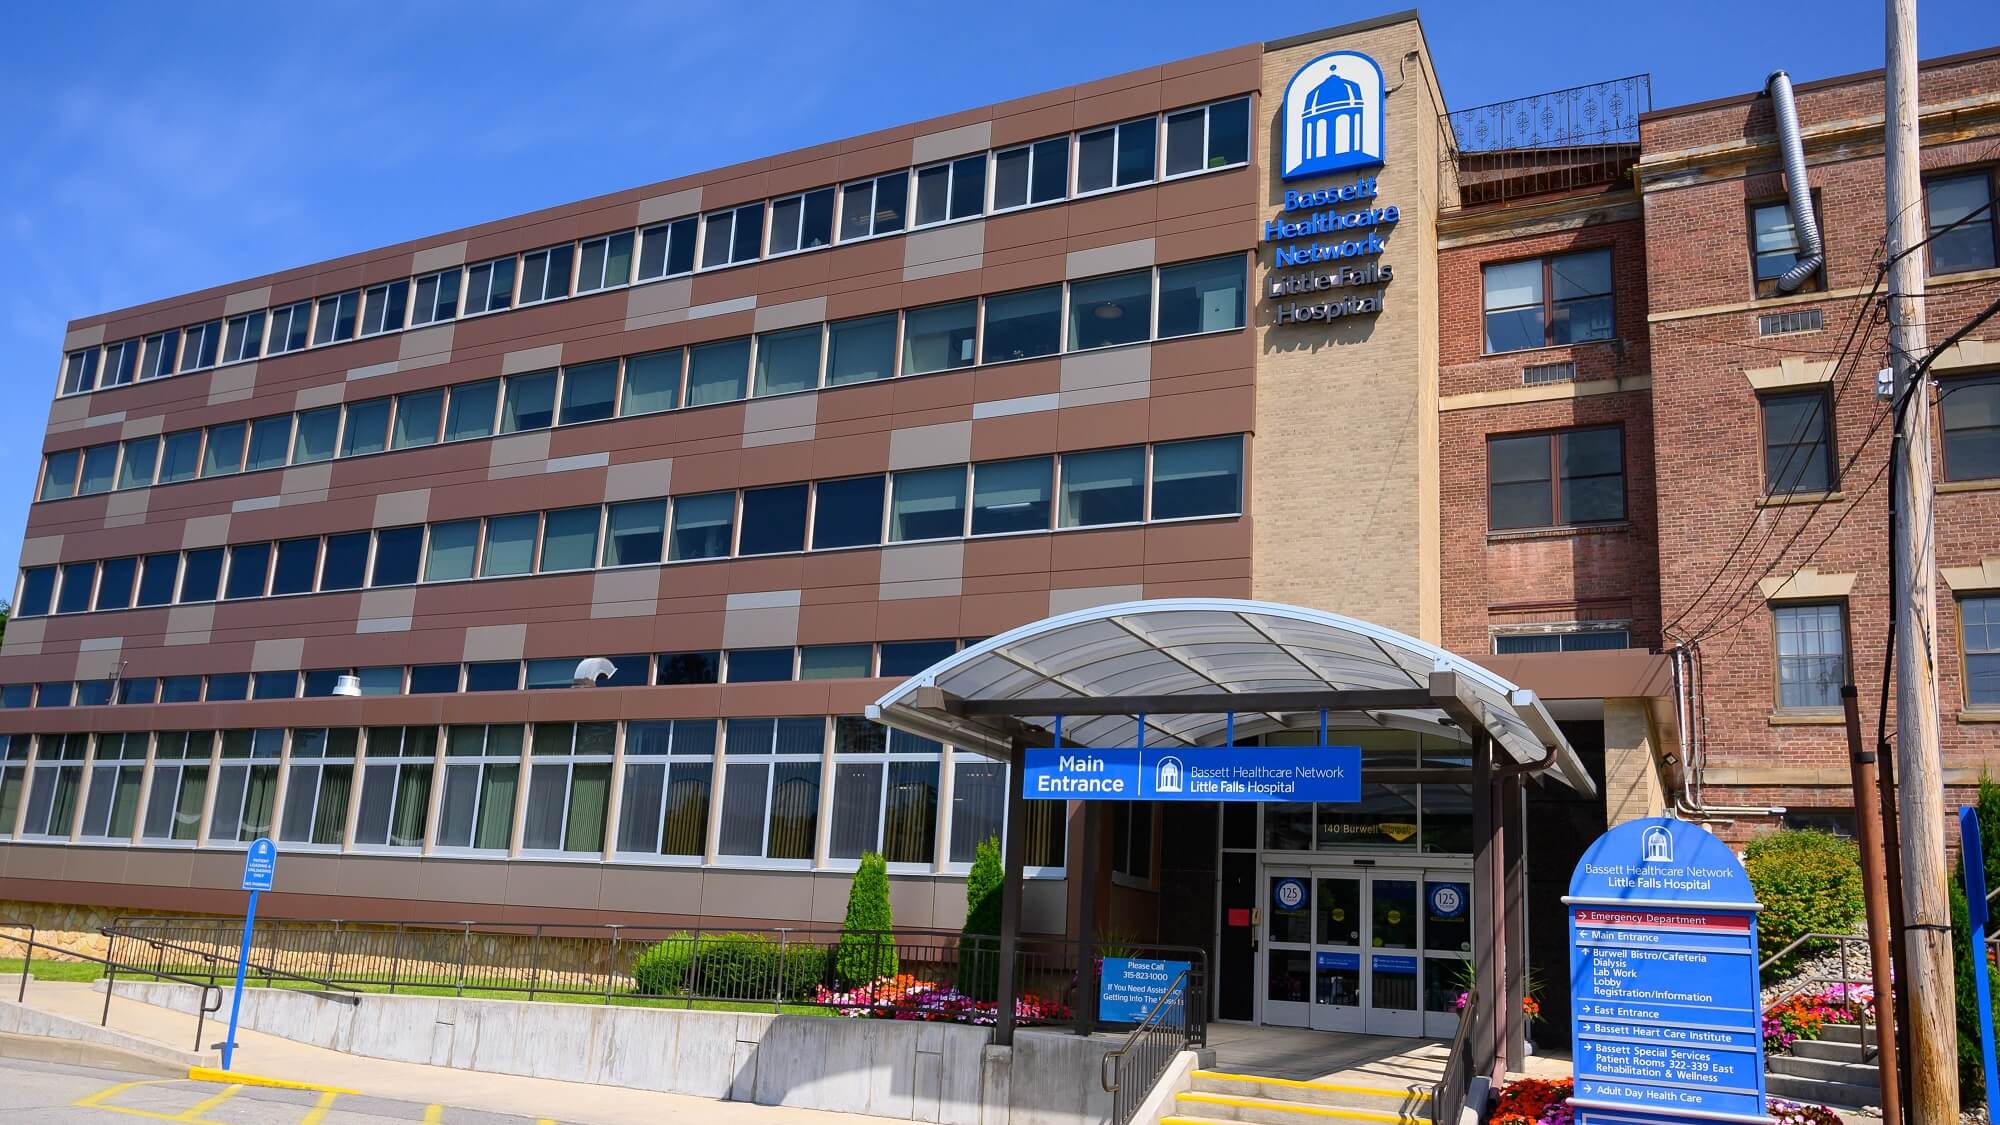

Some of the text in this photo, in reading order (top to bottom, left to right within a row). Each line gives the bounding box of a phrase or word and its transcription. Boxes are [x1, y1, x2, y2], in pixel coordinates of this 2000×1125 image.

[1284, 176, 1377, 213] Bassett
[1264, 205, 1399, 241] Healthcare
[1275, 233, 1384, 269] Network
[1268, 262, 1393, 299] Little Falls
[1277, 288, 1384, 325] Hospital
[1059, 755, 1104, 772] Main
[1191, 766, 1344, 779] Bassett Healthcare Network
[1038, 775, 1124, 792] Entrance
[1190, 781, 1295, 794] Little Falls Hospital
[1324, 824, 1340, 833] 140
[1343, 824, 1378, 833] Burwell
[1585, 864, 1733, 878] Bassett Healthcare Network
[1608, 877, 1711, 891] Little Falls Hospital
[1282, 887, 1298, 899] 125
[1438, 893, 1455, 905] 125
[1591, 911, 1706, 925] Emergency Department
[1592, 931, 1659, 942] Main Entrance
[1593, 949, 1707, 963] Burwell Bistro/Cafeteria
[1593, 958, 1626, 968] Dialysis
[1128, 962, 1164, 971] Please Call
[1593, 968, 1637, 978] Lab Work
[1123, 971, 1168, 981] 315-823-1000
[1593, 977, 1621, 988] Lobby
[1114, 984, 1127, 992] You
[1128, 985, 1145, 993] Need
[1594, 987, 1712, 1002] Registration/Information
[1103, 993, 1128, 1003] Getting
[1130, 994, 1143, 1003] Into
[1144, 995, 1157, 1004] The
[1595, 1006, 1660, 1018] East Entrance
[1595, 1024, 1732, 1042] Bassett Heart Care Institute
[1596, 1044, 1711, 1061] Bassett Special Services
[1596, 1054, 1734, 1073] Patient Rooms 322-339 East
[1596, 1064, 1718, 1082] Rehabilitation & Wellness
[1597, 1086, 1702, 1103] Adult Day Health Care
